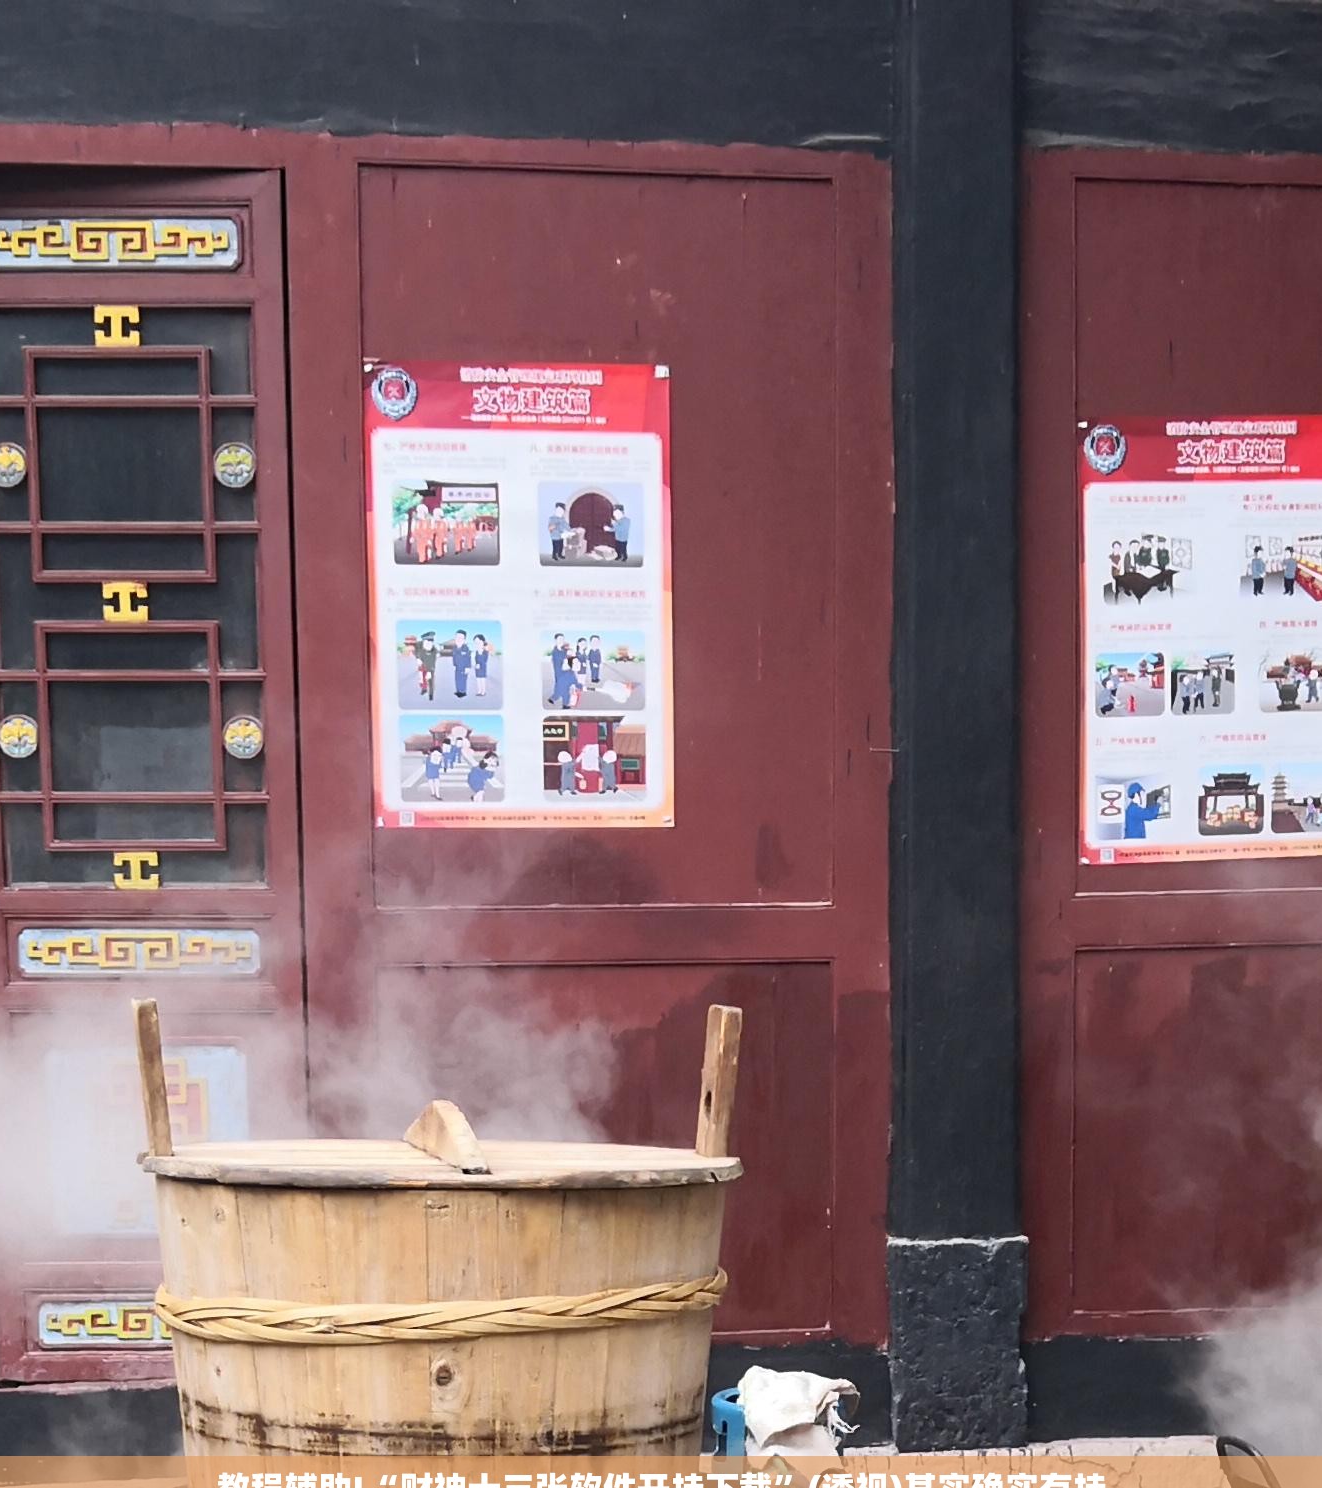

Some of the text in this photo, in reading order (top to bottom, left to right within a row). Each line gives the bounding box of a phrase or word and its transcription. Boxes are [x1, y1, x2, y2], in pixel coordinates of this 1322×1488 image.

[473, 386, 591, 415] 文物建筑篇
[1177, 439, 1285, 464] 文物建筑篇
